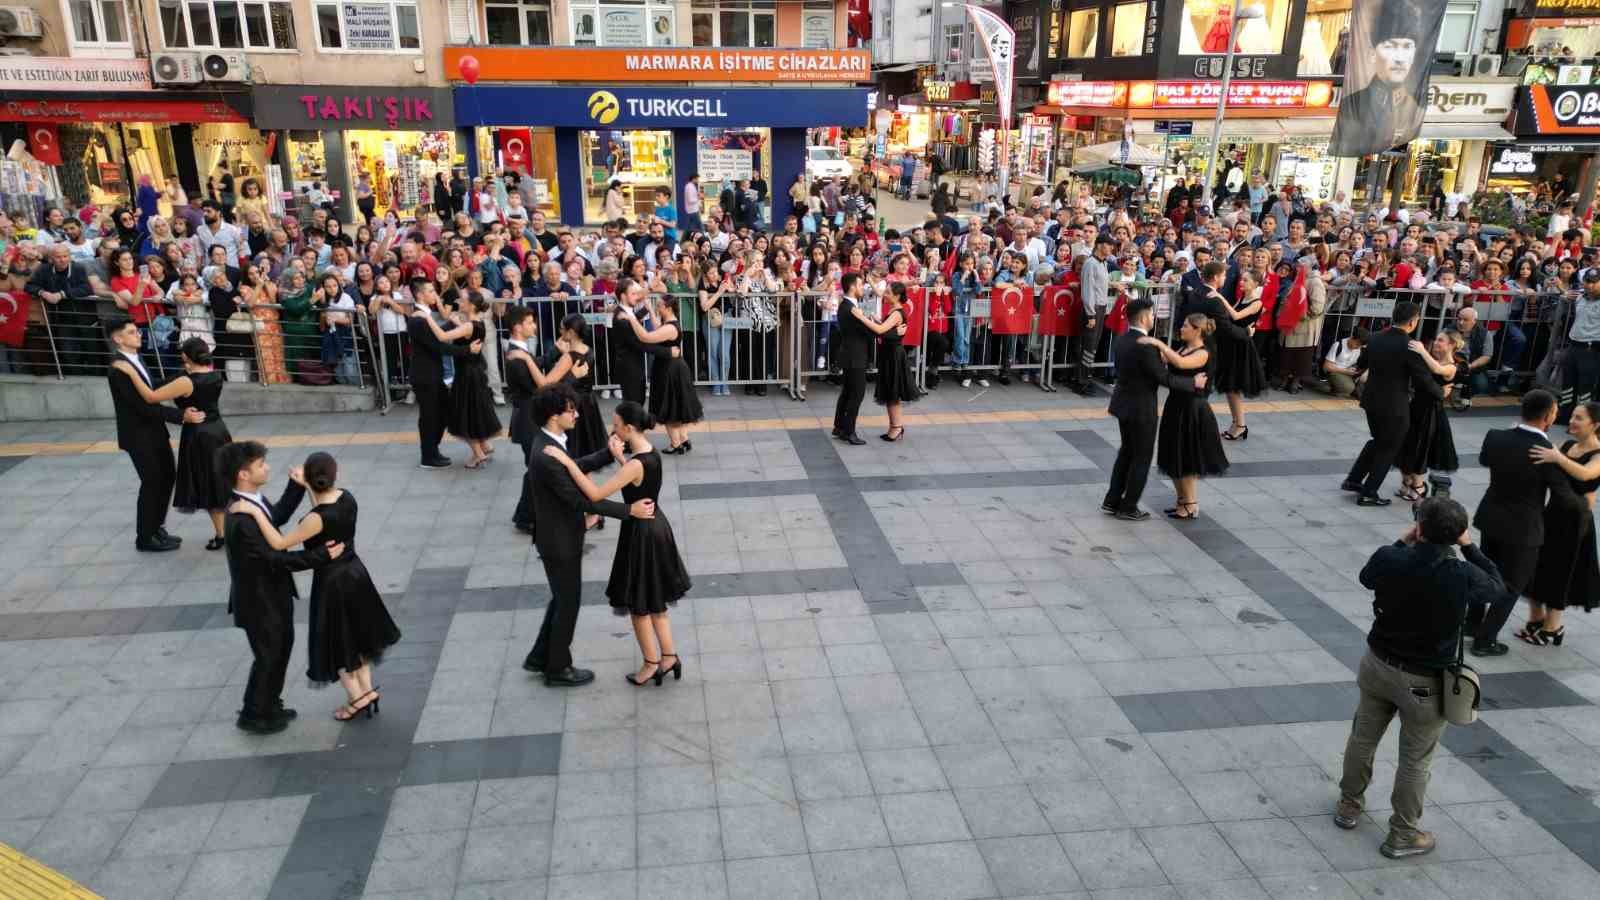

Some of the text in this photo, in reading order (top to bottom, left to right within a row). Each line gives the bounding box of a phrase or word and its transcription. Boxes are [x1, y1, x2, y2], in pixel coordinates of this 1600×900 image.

[625, 52, 866, 74] MARMARA İŞİTME CİHAZLARI
[1194, 57, 1267, 78] GÜSE
[11, 69, 23, 80] VE
[1192, 82, 1253, 96] DÖRLER
[1260, 85, 1303, 96] YUFKA
[626, 98, 728, 117] TURKCELL
